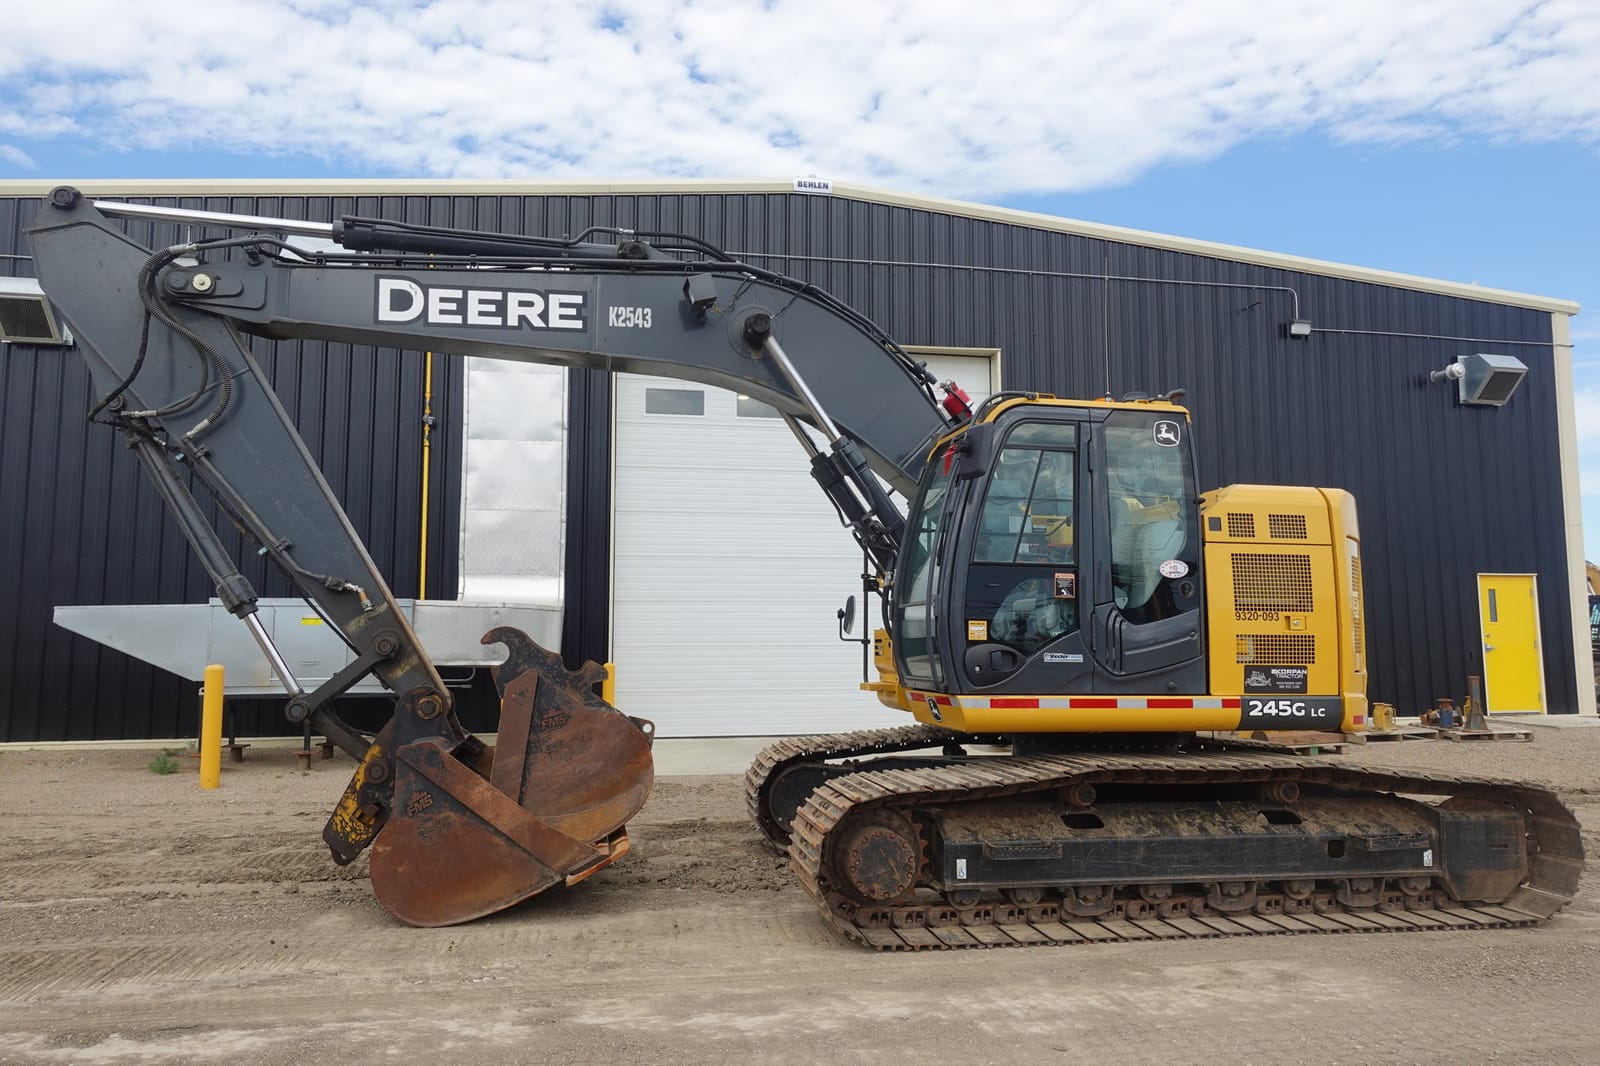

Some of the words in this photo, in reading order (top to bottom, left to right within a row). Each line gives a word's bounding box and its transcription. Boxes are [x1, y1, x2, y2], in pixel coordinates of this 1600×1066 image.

[797, 180, 829, 190] BEHLEN
[378, 278, 583, 329] DEERE
[608, 306, 652, 328] K2543
[1235, 611, 1279, 621] 9320-093
[1248, 700, 1306, 717] 245G
[1311, 708, 1326, 717] LC
